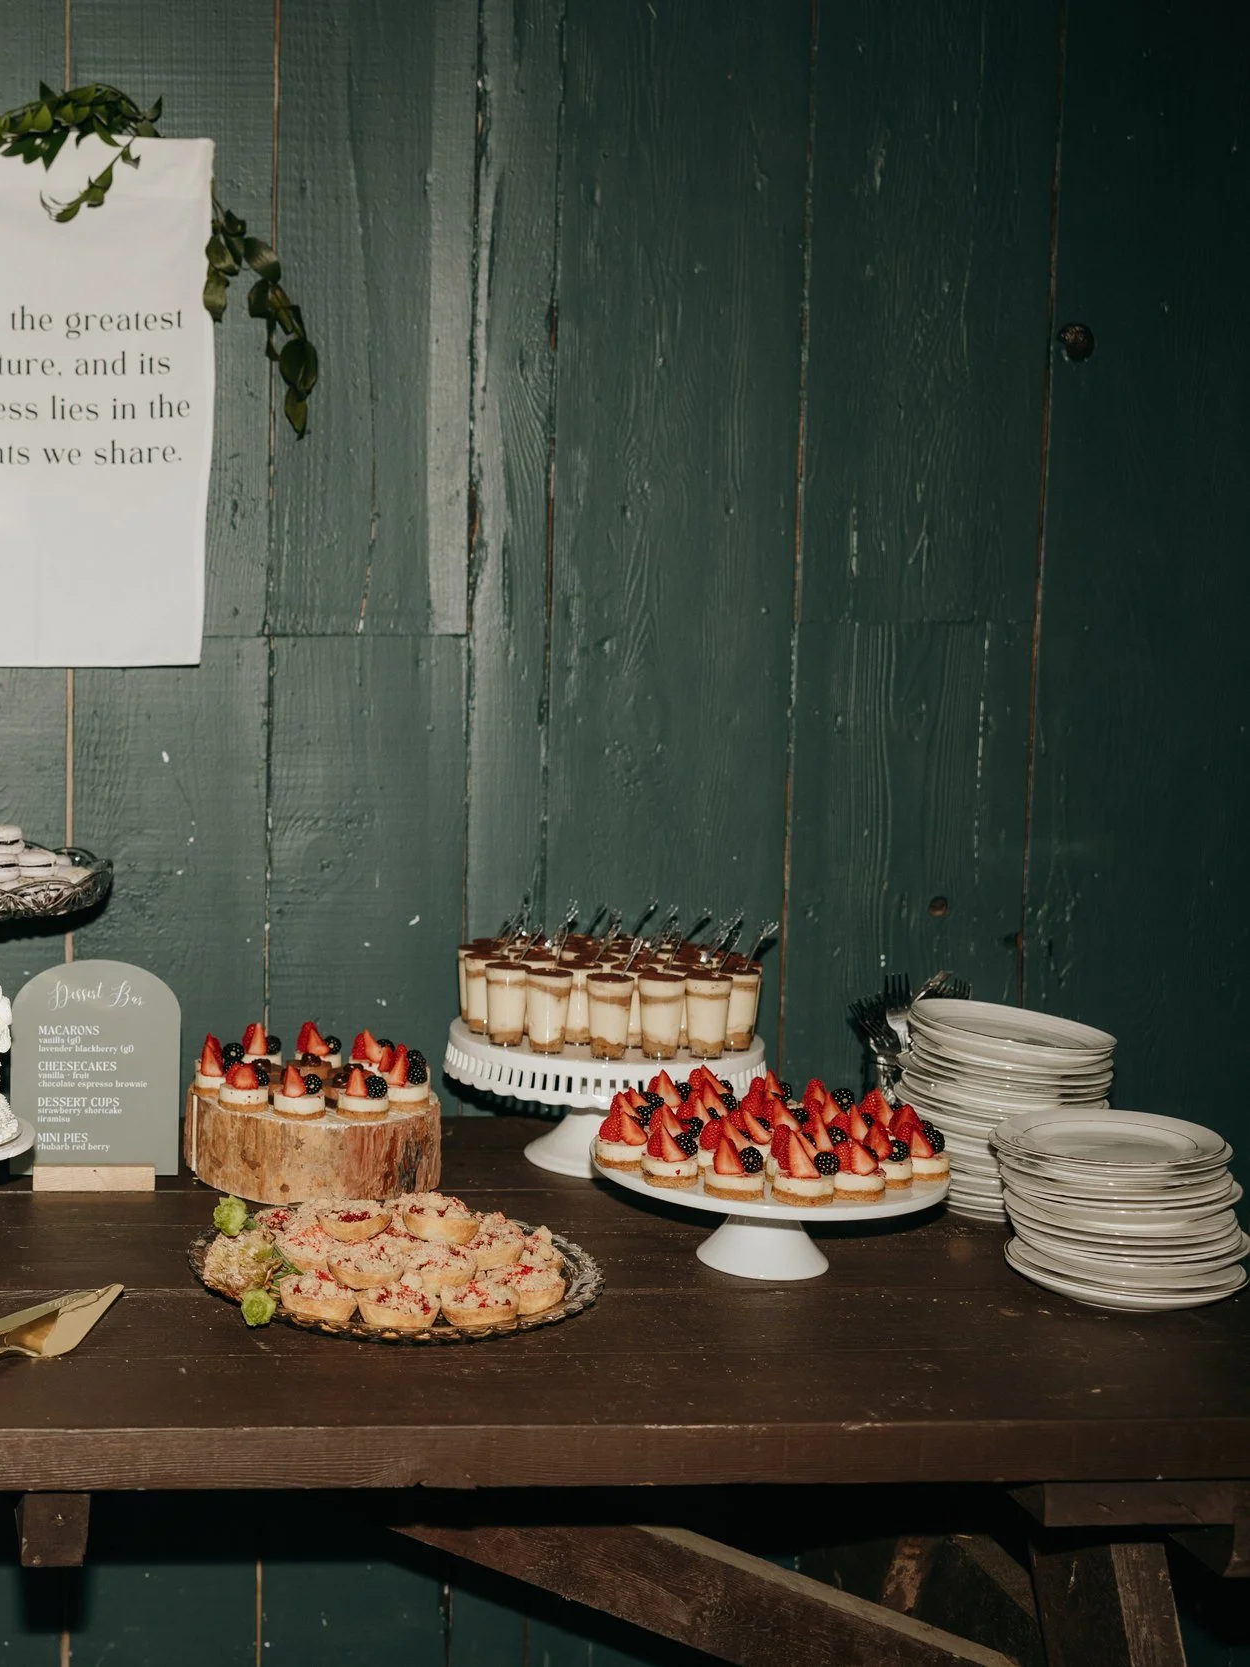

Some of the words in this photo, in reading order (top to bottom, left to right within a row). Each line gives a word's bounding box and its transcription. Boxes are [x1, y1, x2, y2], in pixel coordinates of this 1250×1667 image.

[11, 306, 53, 331] the
[66, 309, 183, 339] greatest
[75, 352, 126, 375] and
[139, 353, 170, 374] its
[51, 396, 99, 420] lies
[112, 399, 135, 420] in
[150, 394, 190, 418] the
[43, 448, 81, 464] we
[95, 440, 182, 464] share.
[48, 980, 103, 1011] Dessert
[108, 980, 145, 1007] Bar
[38, 1025, 99, 1036] MACARONS
[38, 1036, 64, 1044] vanilla
[67, 1036, 81, 1045] (gf)
[75, 1045, 118, 1054] blackberry
[120, 1045, 134, 1054] (gf)
[38, 1061, 117, 1071] CHEESECAKES
[38, 1071, 64, 1079] vanilla
[38, 1080, 75, 1088] chocolate
[78, 1081, 113, 1089] espresso
[38, 1097, 87, 1107] DESSERT
[91, 1098, 119, 1107] CUPS
[38, 1107, 81, 1116] strawberry
[37, 1115, 70, 1123] tiramisu
[37, 1133, 60, 1142] MINI
[64, 1133, 88, 1143] PIES
[88, 1143, 110, 1152] berry
